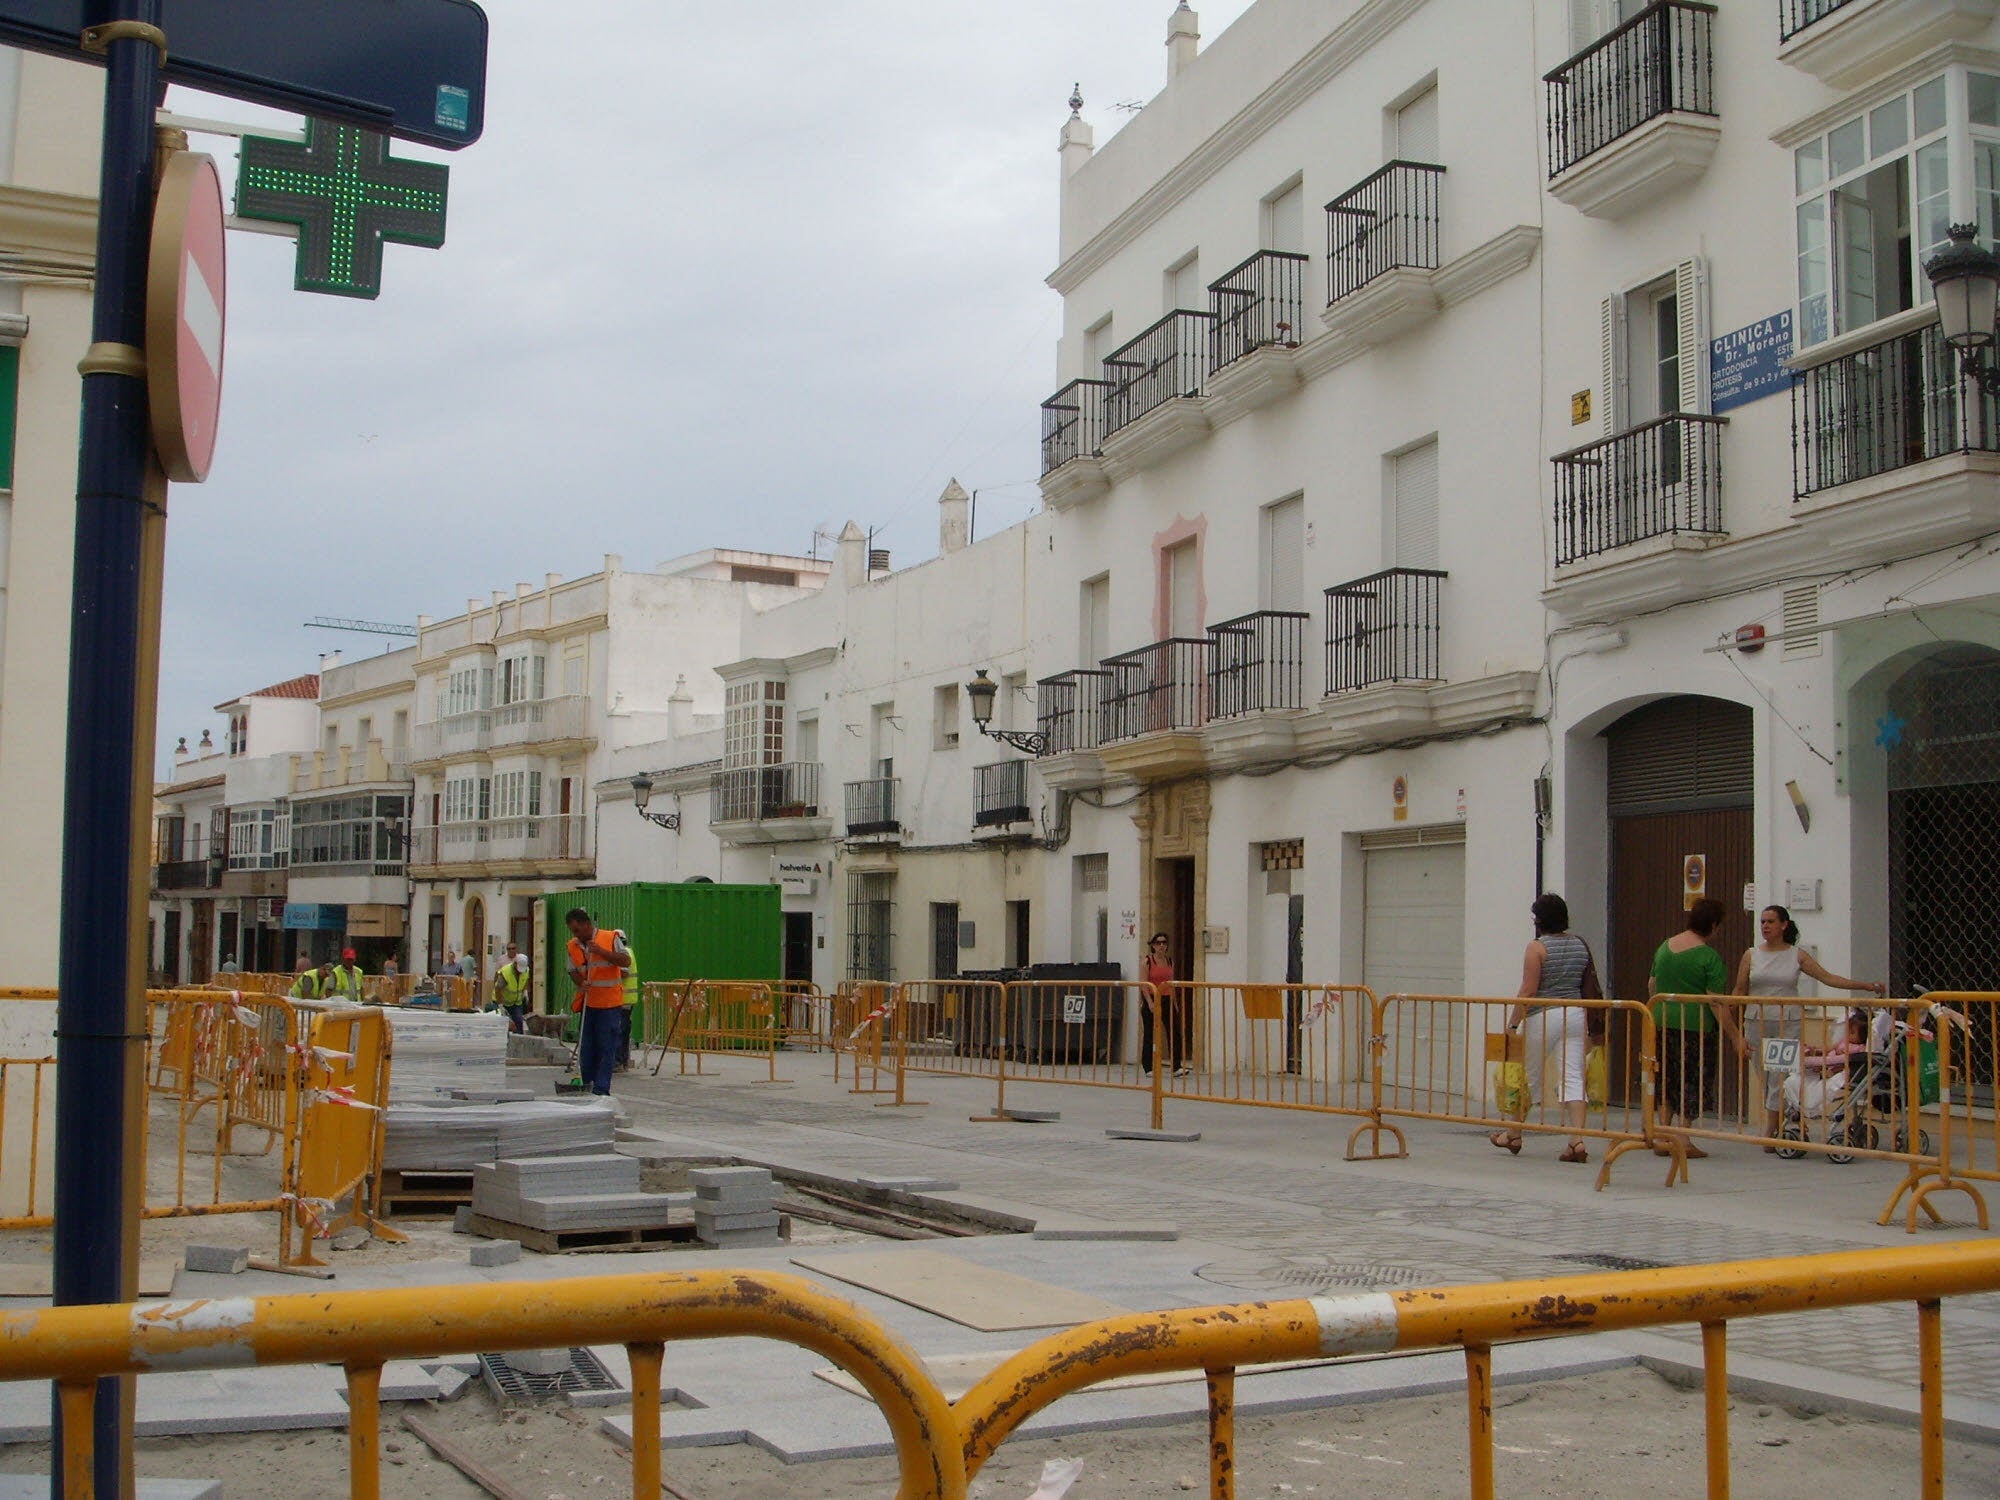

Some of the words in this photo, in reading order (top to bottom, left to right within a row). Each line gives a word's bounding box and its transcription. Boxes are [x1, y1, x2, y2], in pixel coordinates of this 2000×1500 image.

[1714, 320, 1773, 354] CLINICA
[1725, 350, 1742, 364] Dr.
[1747, 331, 1789, 355] Moreno
[1711, 356, 1758, 381] ORTODONCIA
[1767, 372, 1773, 382] 2
